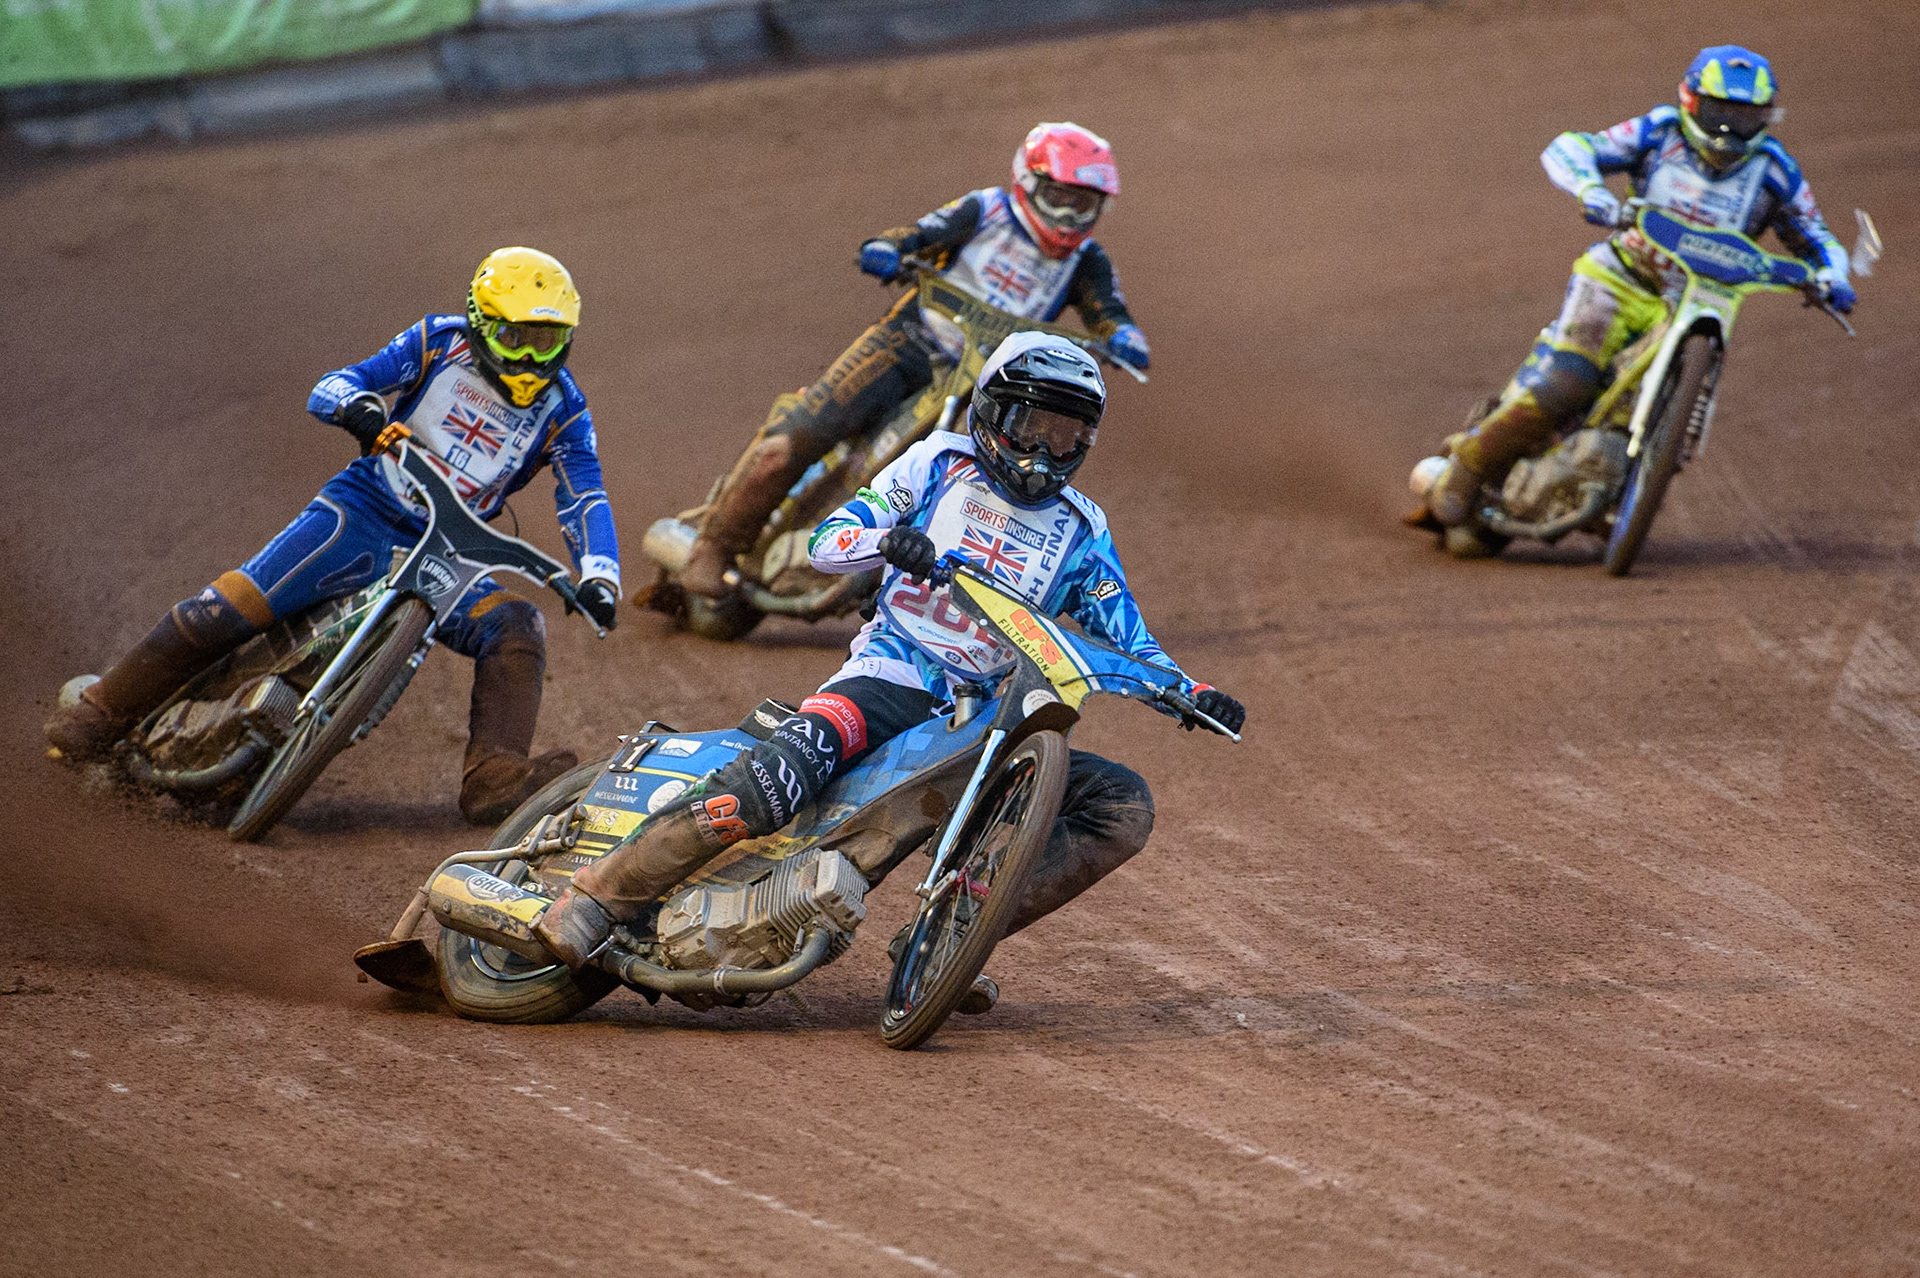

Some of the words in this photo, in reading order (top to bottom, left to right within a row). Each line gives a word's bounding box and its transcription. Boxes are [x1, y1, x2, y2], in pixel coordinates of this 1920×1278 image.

[963, 501, 1007, 531] SPORTS
[1005, 520, 1045, 551] INSURE
[1040, 505, 1072, 573] FINAL
[421, 559, 455, 590] LAWSON
[998, 618, 1051, 672] FILTRATION
[1009, 608, 1063, 666] CFS
[774, 729, 820, 765] UNTANCY
[705, 793, 750, 845] CFS
